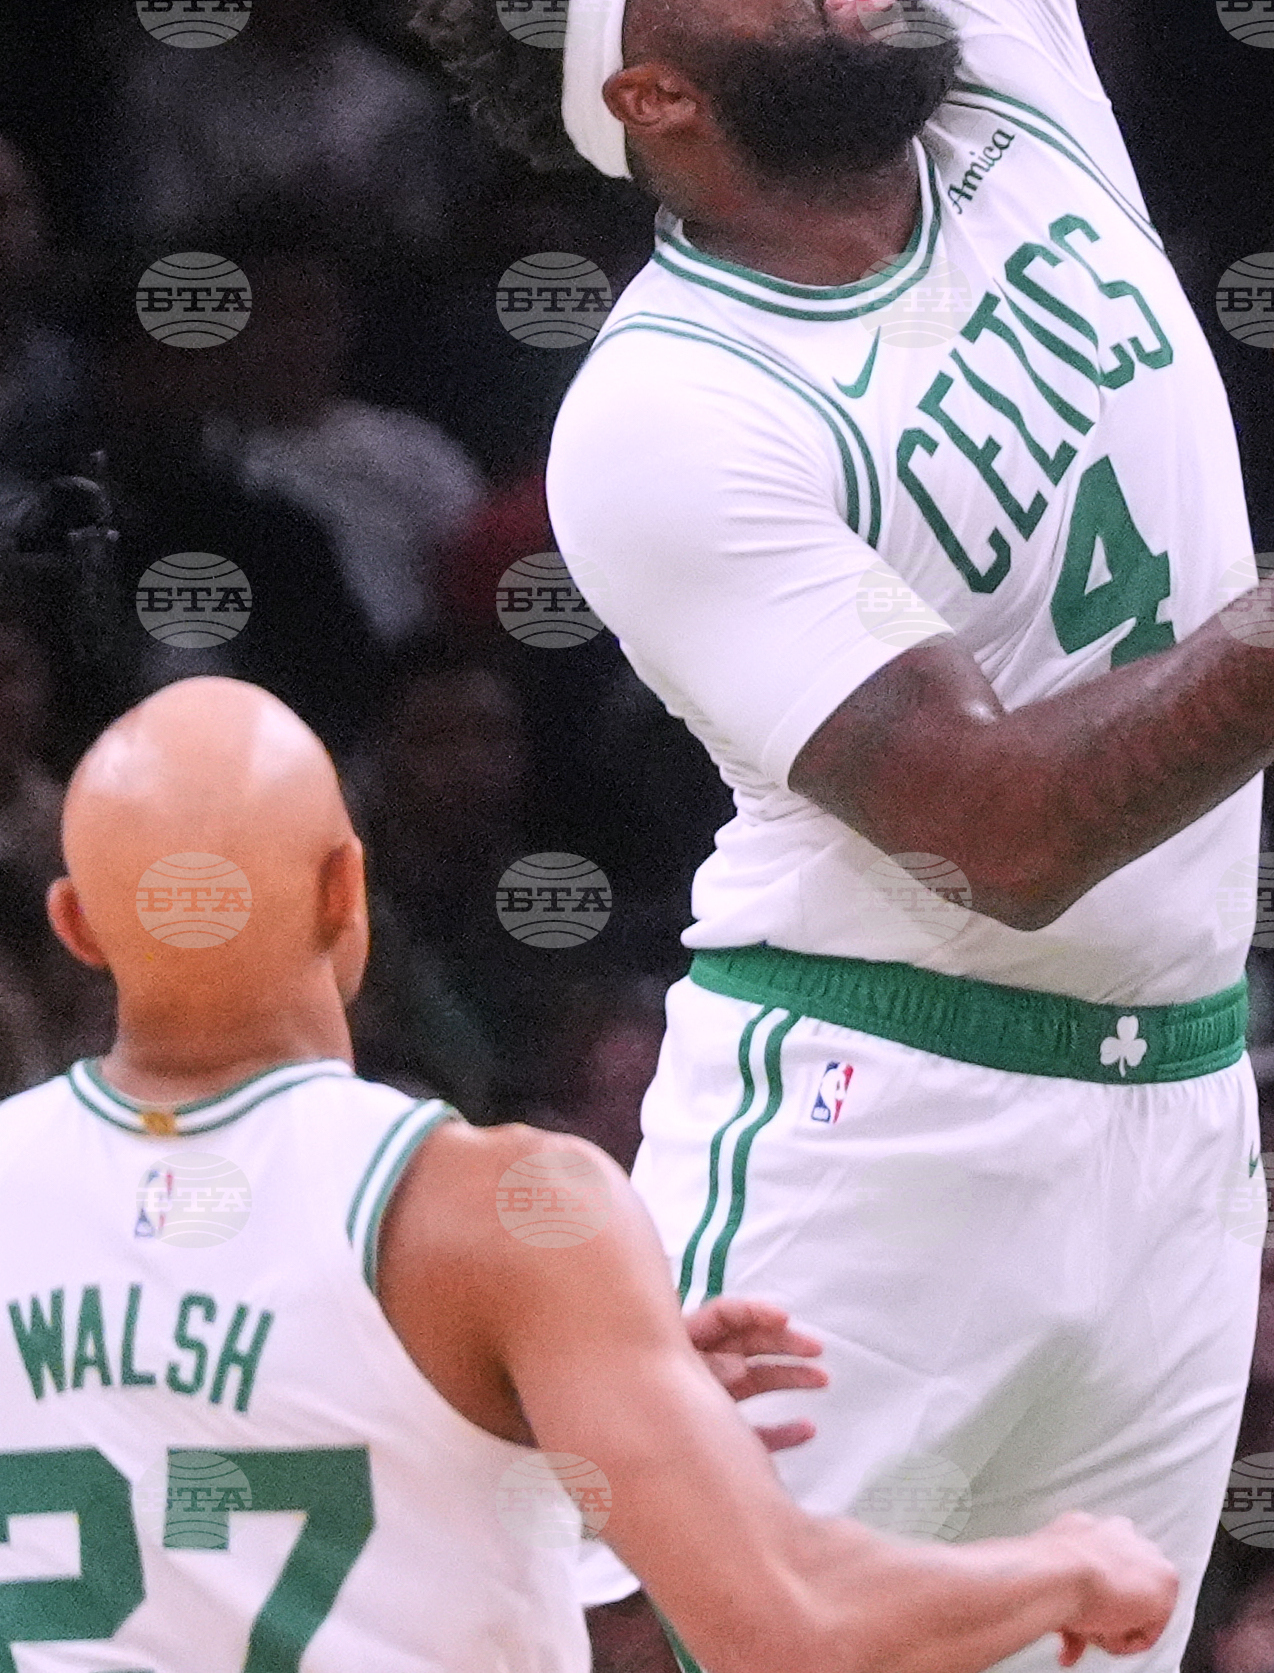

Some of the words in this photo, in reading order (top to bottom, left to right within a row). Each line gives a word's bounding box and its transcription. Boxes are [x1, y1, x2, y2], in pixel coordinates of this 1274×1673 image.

[948, 129, 1015, 214] Amica
[897, 213, 1173, 595] CELTICS
[1051, 454, 1175, 668] 4
[8, 1283, 275, 1412] WALSH
[0, 1445, 376, 1673] 27
